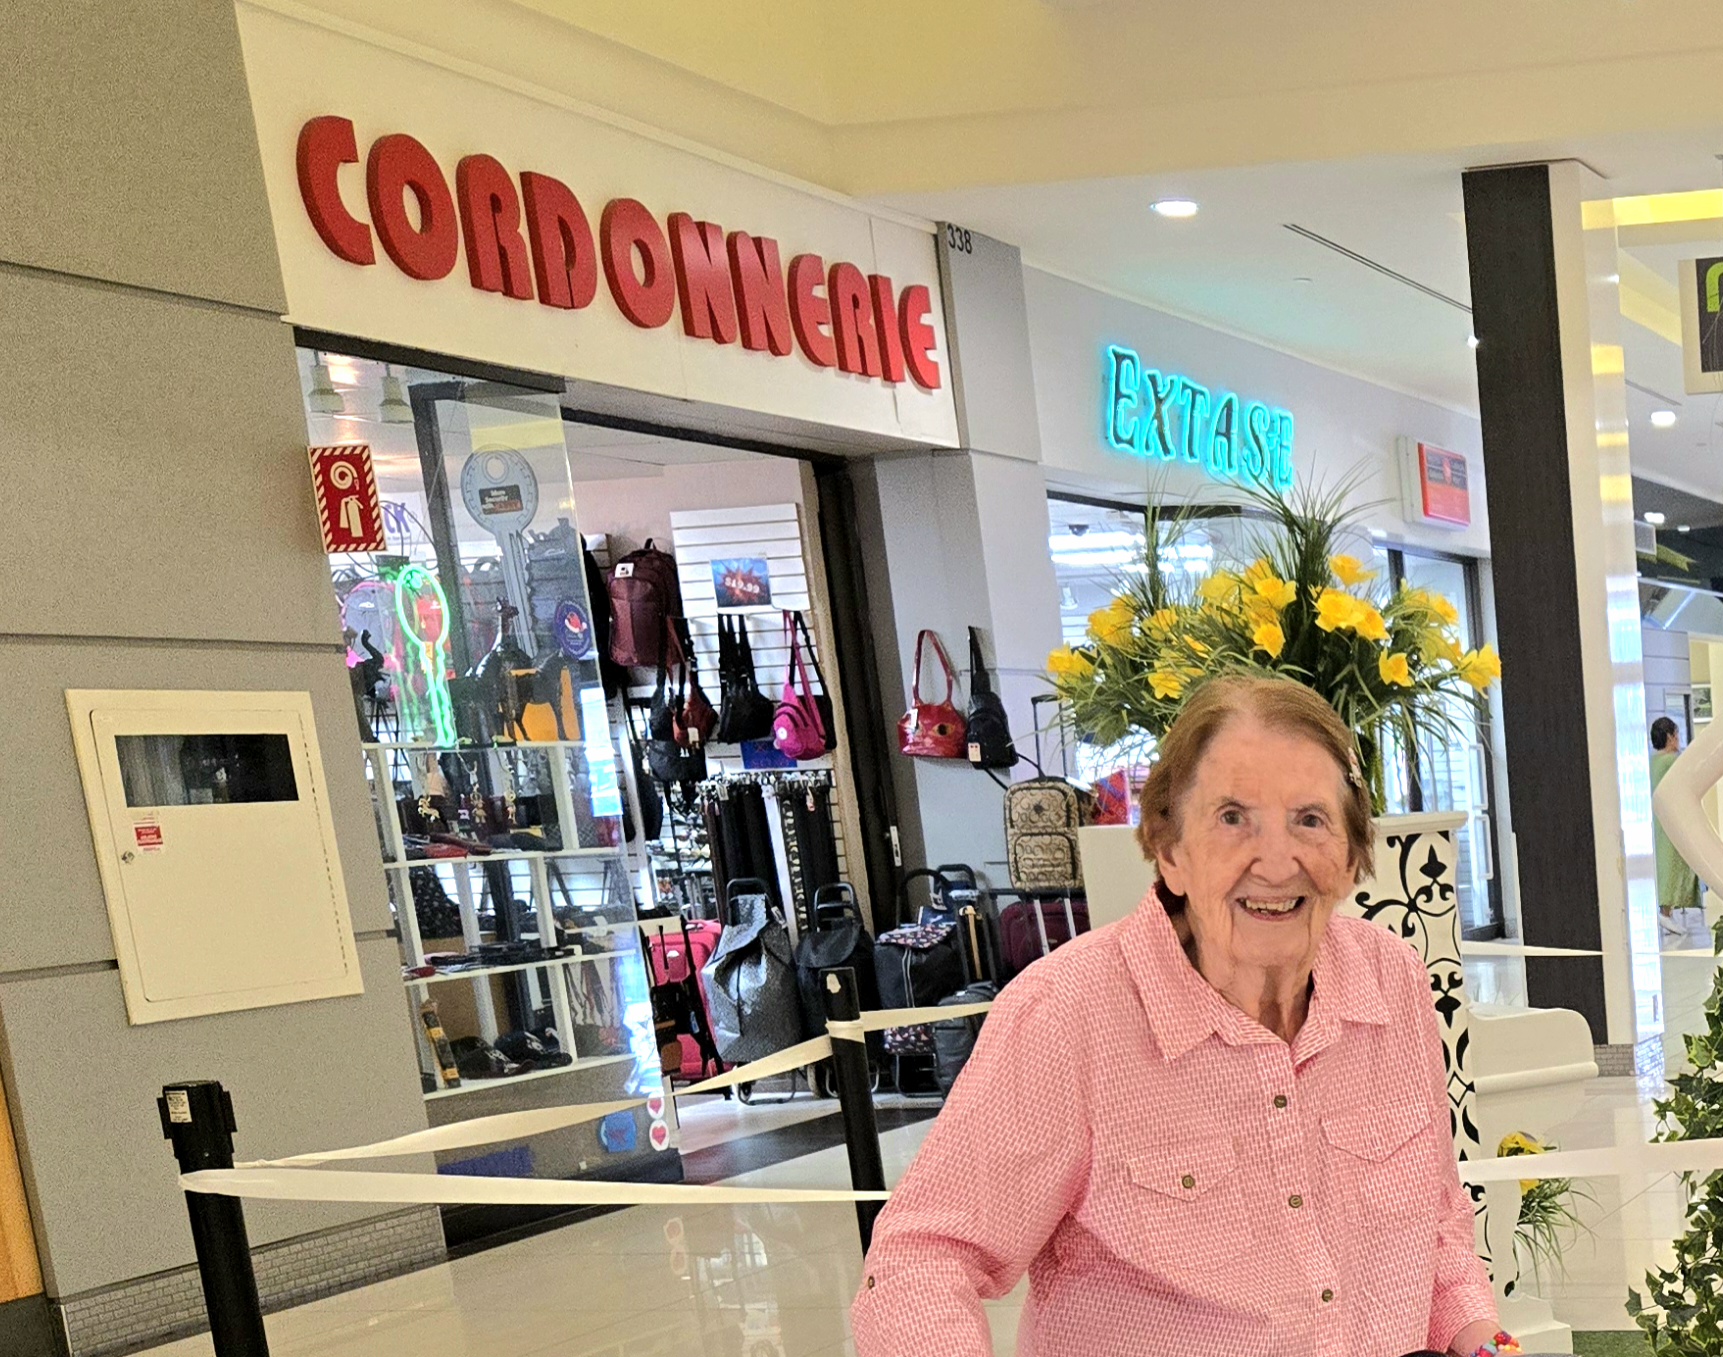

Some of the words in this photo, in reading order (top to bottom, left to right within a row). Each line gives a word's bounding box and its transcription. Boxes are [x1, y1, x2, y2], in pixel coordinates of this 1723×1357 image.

[296, 114, 943, 391] CORDONNERIE
[946, 222, 973, 255] 338
[1107, 344, 1294, 490] EXTASE
